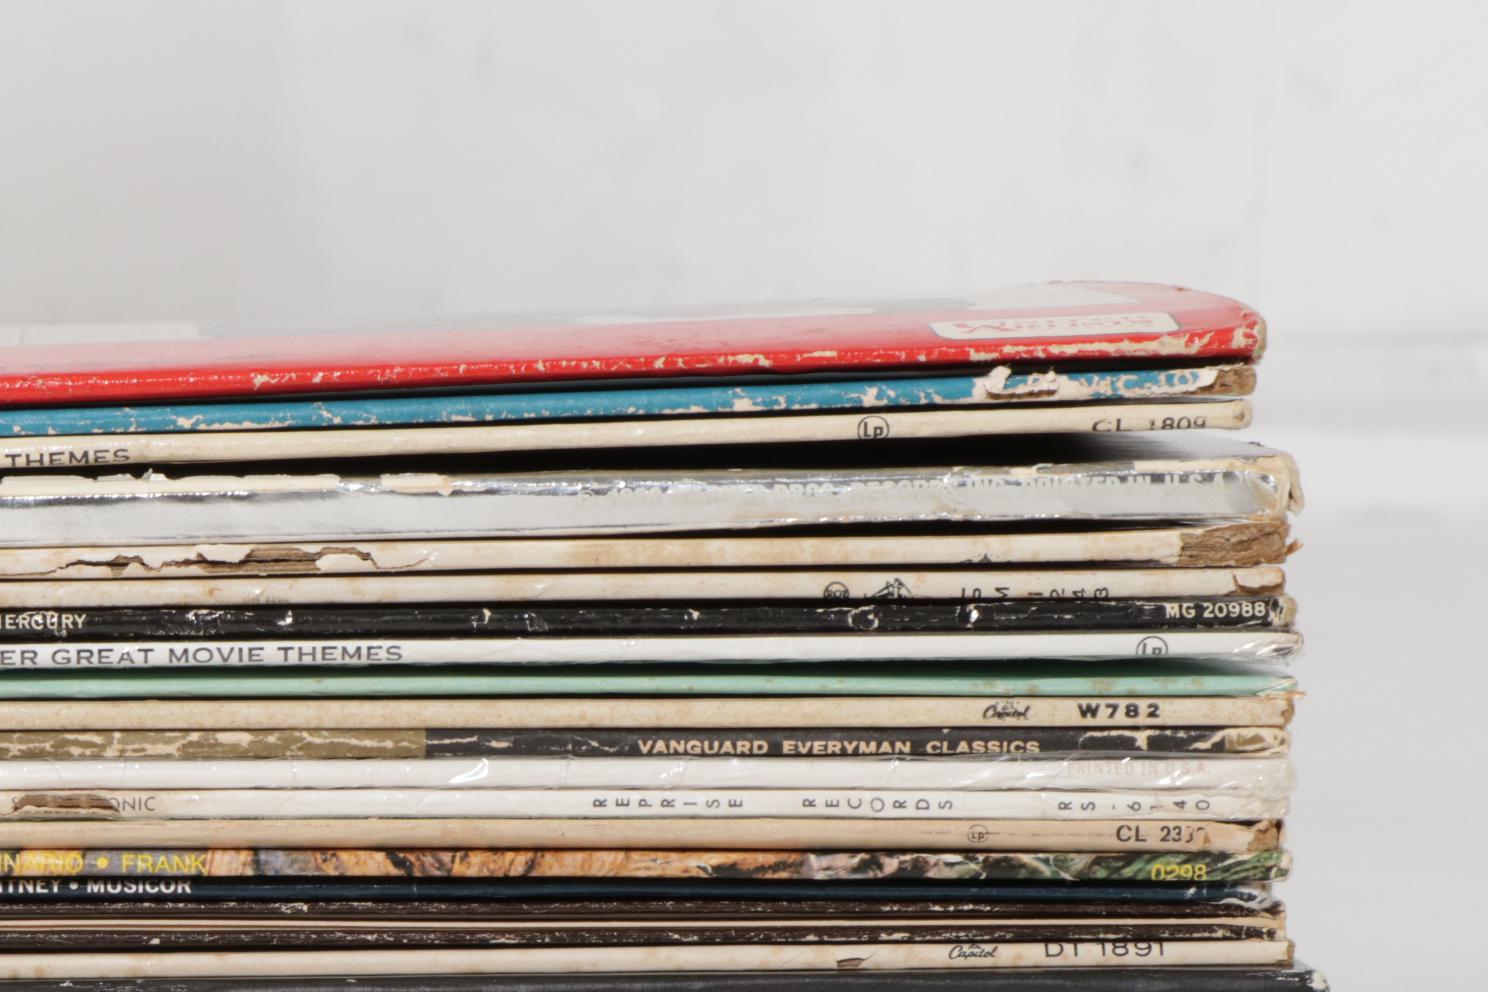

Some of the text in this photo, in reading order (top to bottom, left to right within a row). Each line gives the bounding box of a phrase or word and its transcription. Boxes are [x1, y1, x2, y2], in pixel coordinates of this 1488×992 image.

[1092, 417, 1132, 433] CL
[5, 448, 132, 470] THEMES
[1165, 600, 1268, 620] MG 20988
[50, 646, 156, 666] GREAT
[168, 646, 265, 664] MOVIE
[276, 644, 404, 662] THEMES
[636, 738, 1042, 756] VANGUARD EVERYMAN CLASSICS
[592, 797, 954, 813] REPRISE RECORDS
[1115, 824, 1147, 843] CL
[120, 852, 208, 873] FRANK
[86, 879, 194, 894] MUSICOR
[948, 945, 999, 961] Capitol
